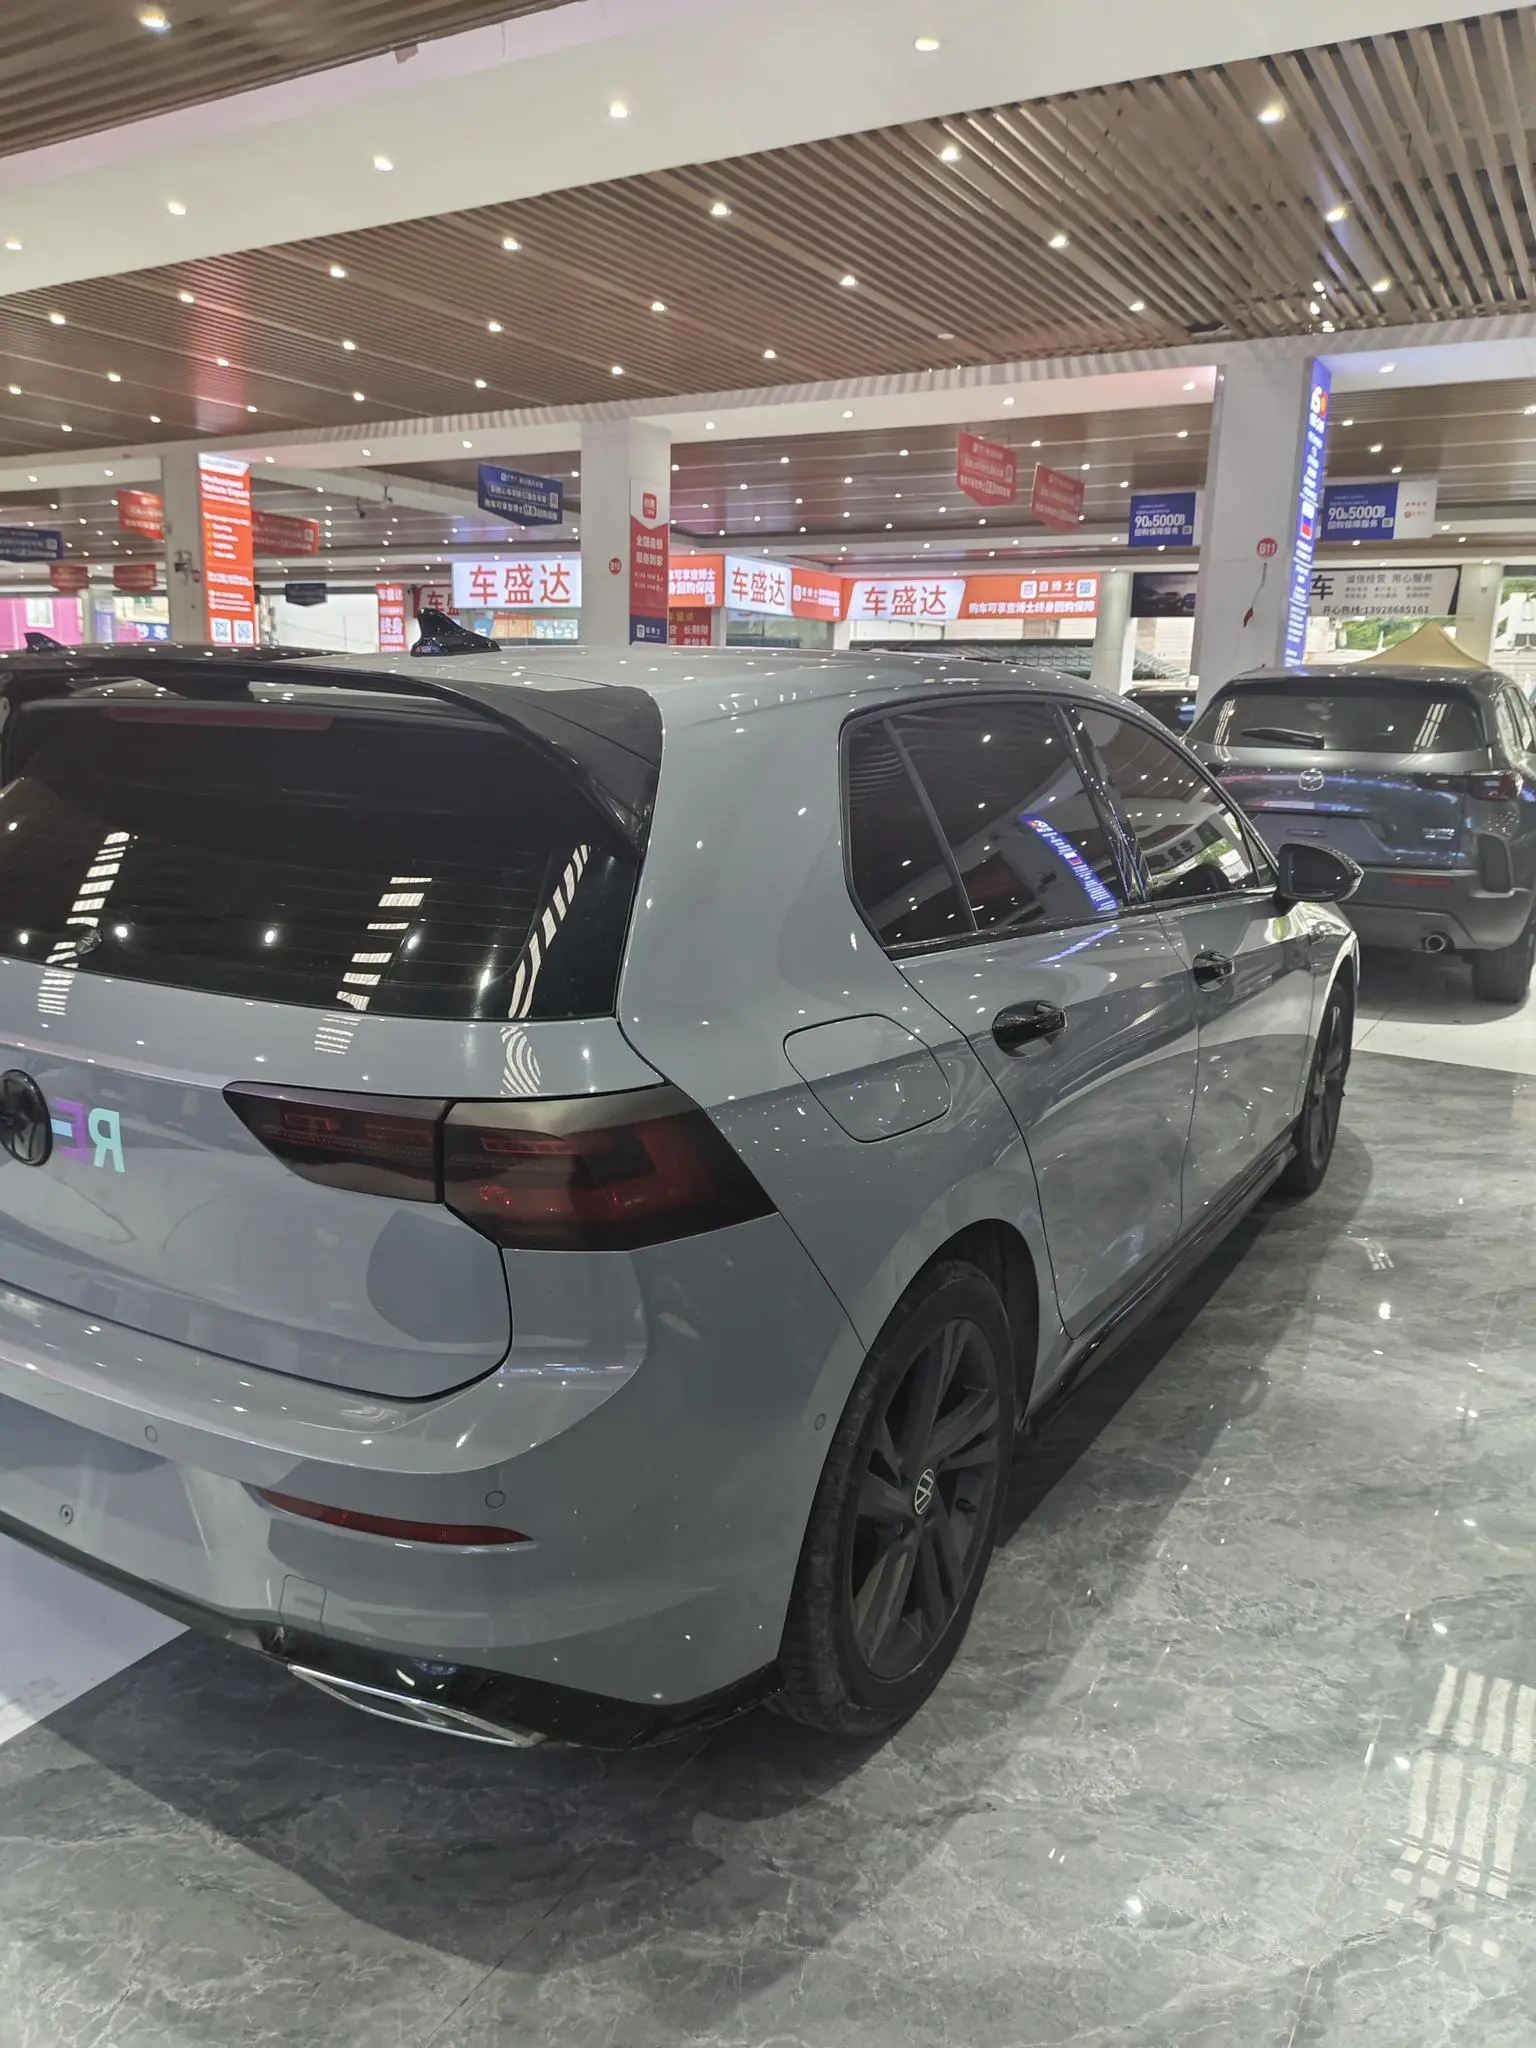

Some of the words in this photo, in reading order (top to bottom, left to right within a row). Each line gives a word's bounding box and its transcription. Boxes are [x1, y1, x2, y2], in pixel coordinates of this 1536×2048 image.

[1259, 542, 1276, 554] B11
[470, 563, 571, 605] 车盛达
[732, 566, 785, 606] 车盛达
[1391, 573, 1433, 584] 用心服务
[863, 584, 948, 617] 车盛达
